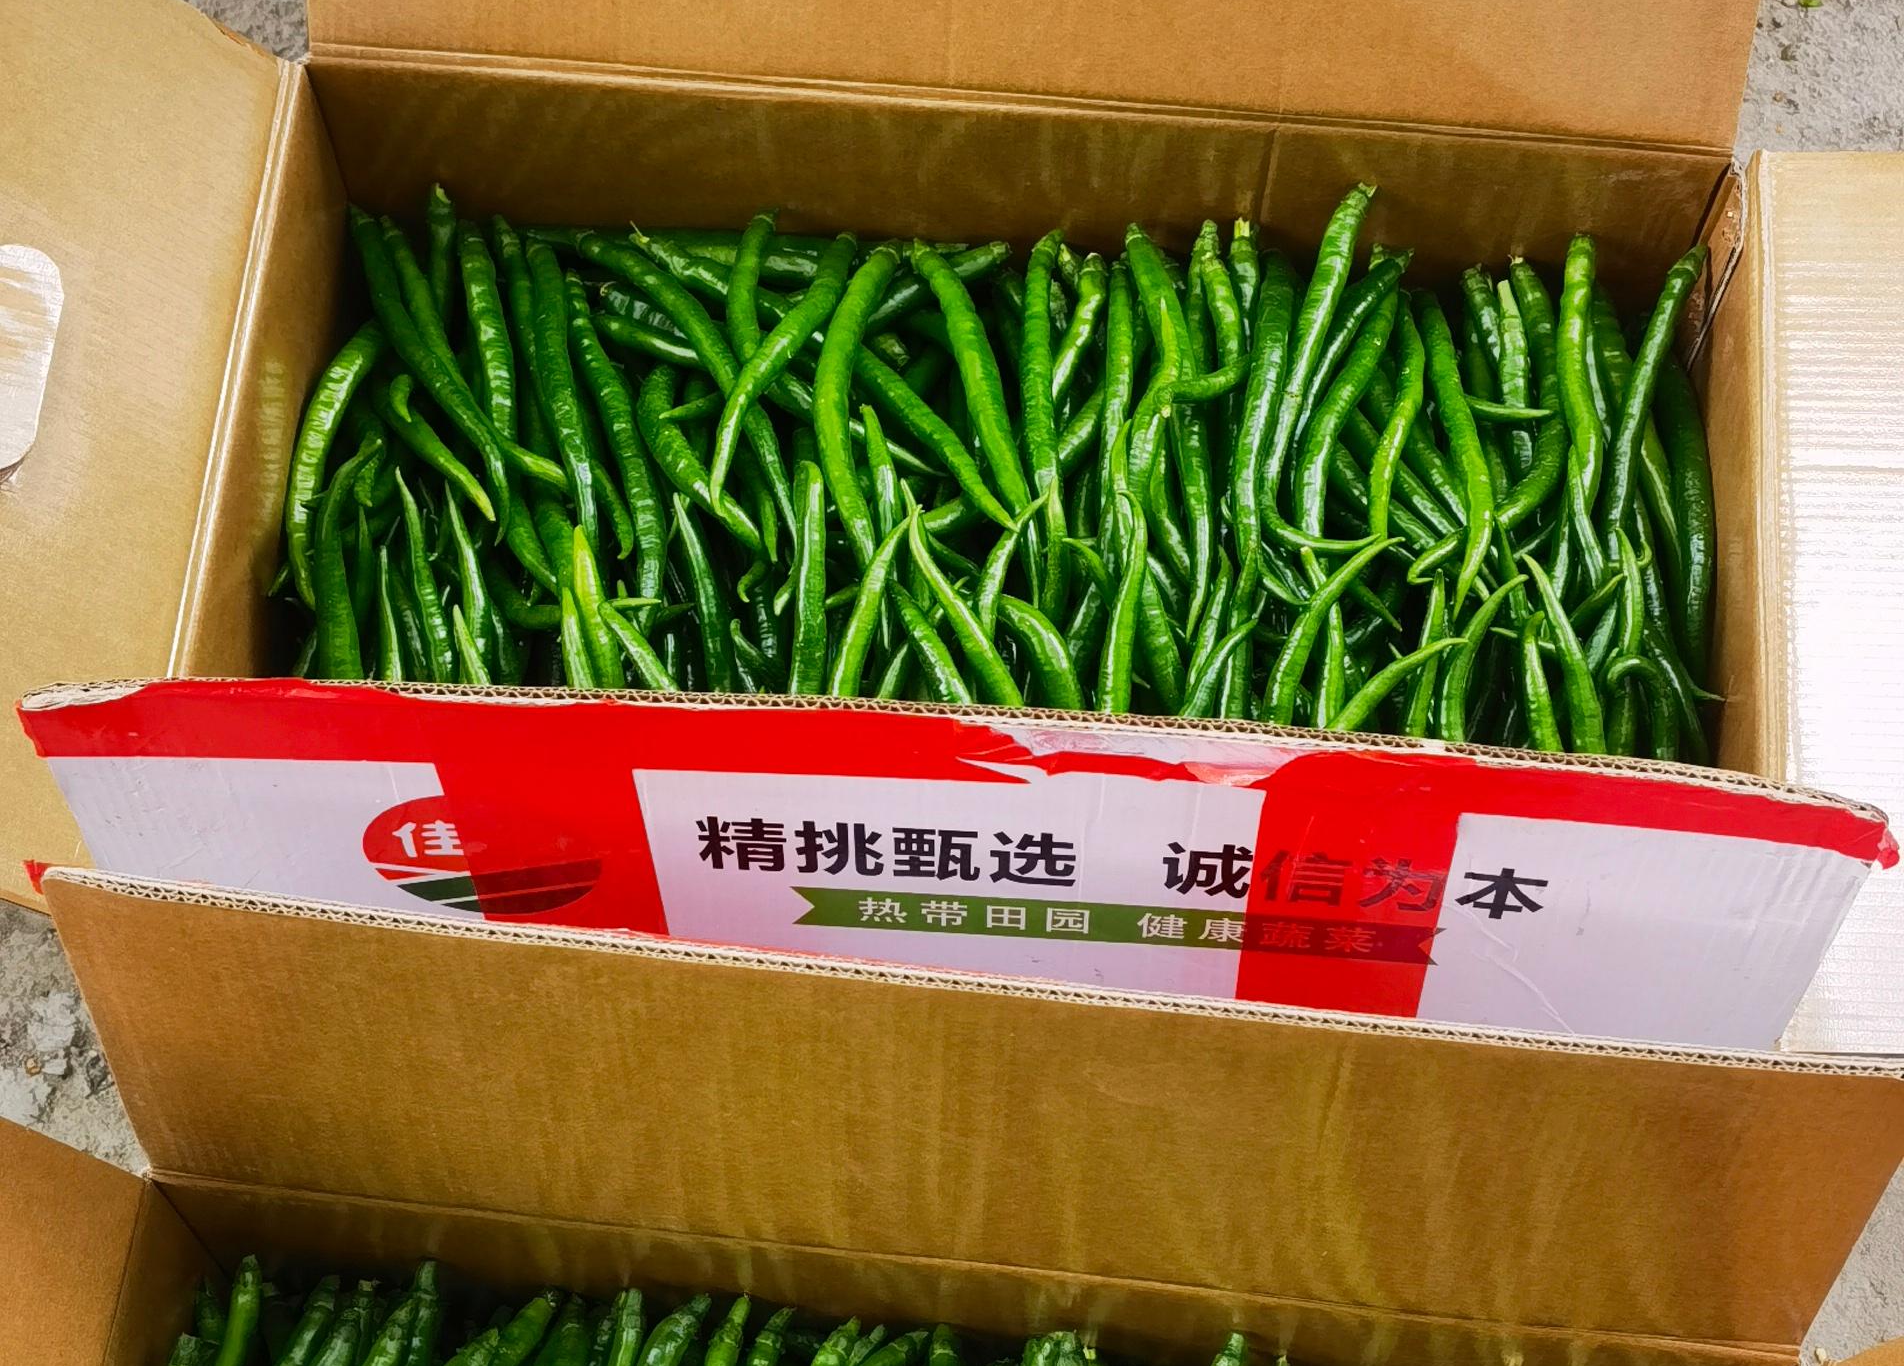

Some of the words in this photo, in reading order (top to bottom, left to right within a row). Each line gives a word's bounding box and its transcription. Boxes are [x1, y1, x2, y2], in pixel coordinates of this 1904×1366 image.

[392, 819, 465, 859] 佳
[695, 815, 1077, 888] 精挑甄选
[1161, 841, 1550, 920] 诚信为本
[858, 896, 1092, 935] 热带田园
[1136, 912, 1378, 953] 健康蔬菜
